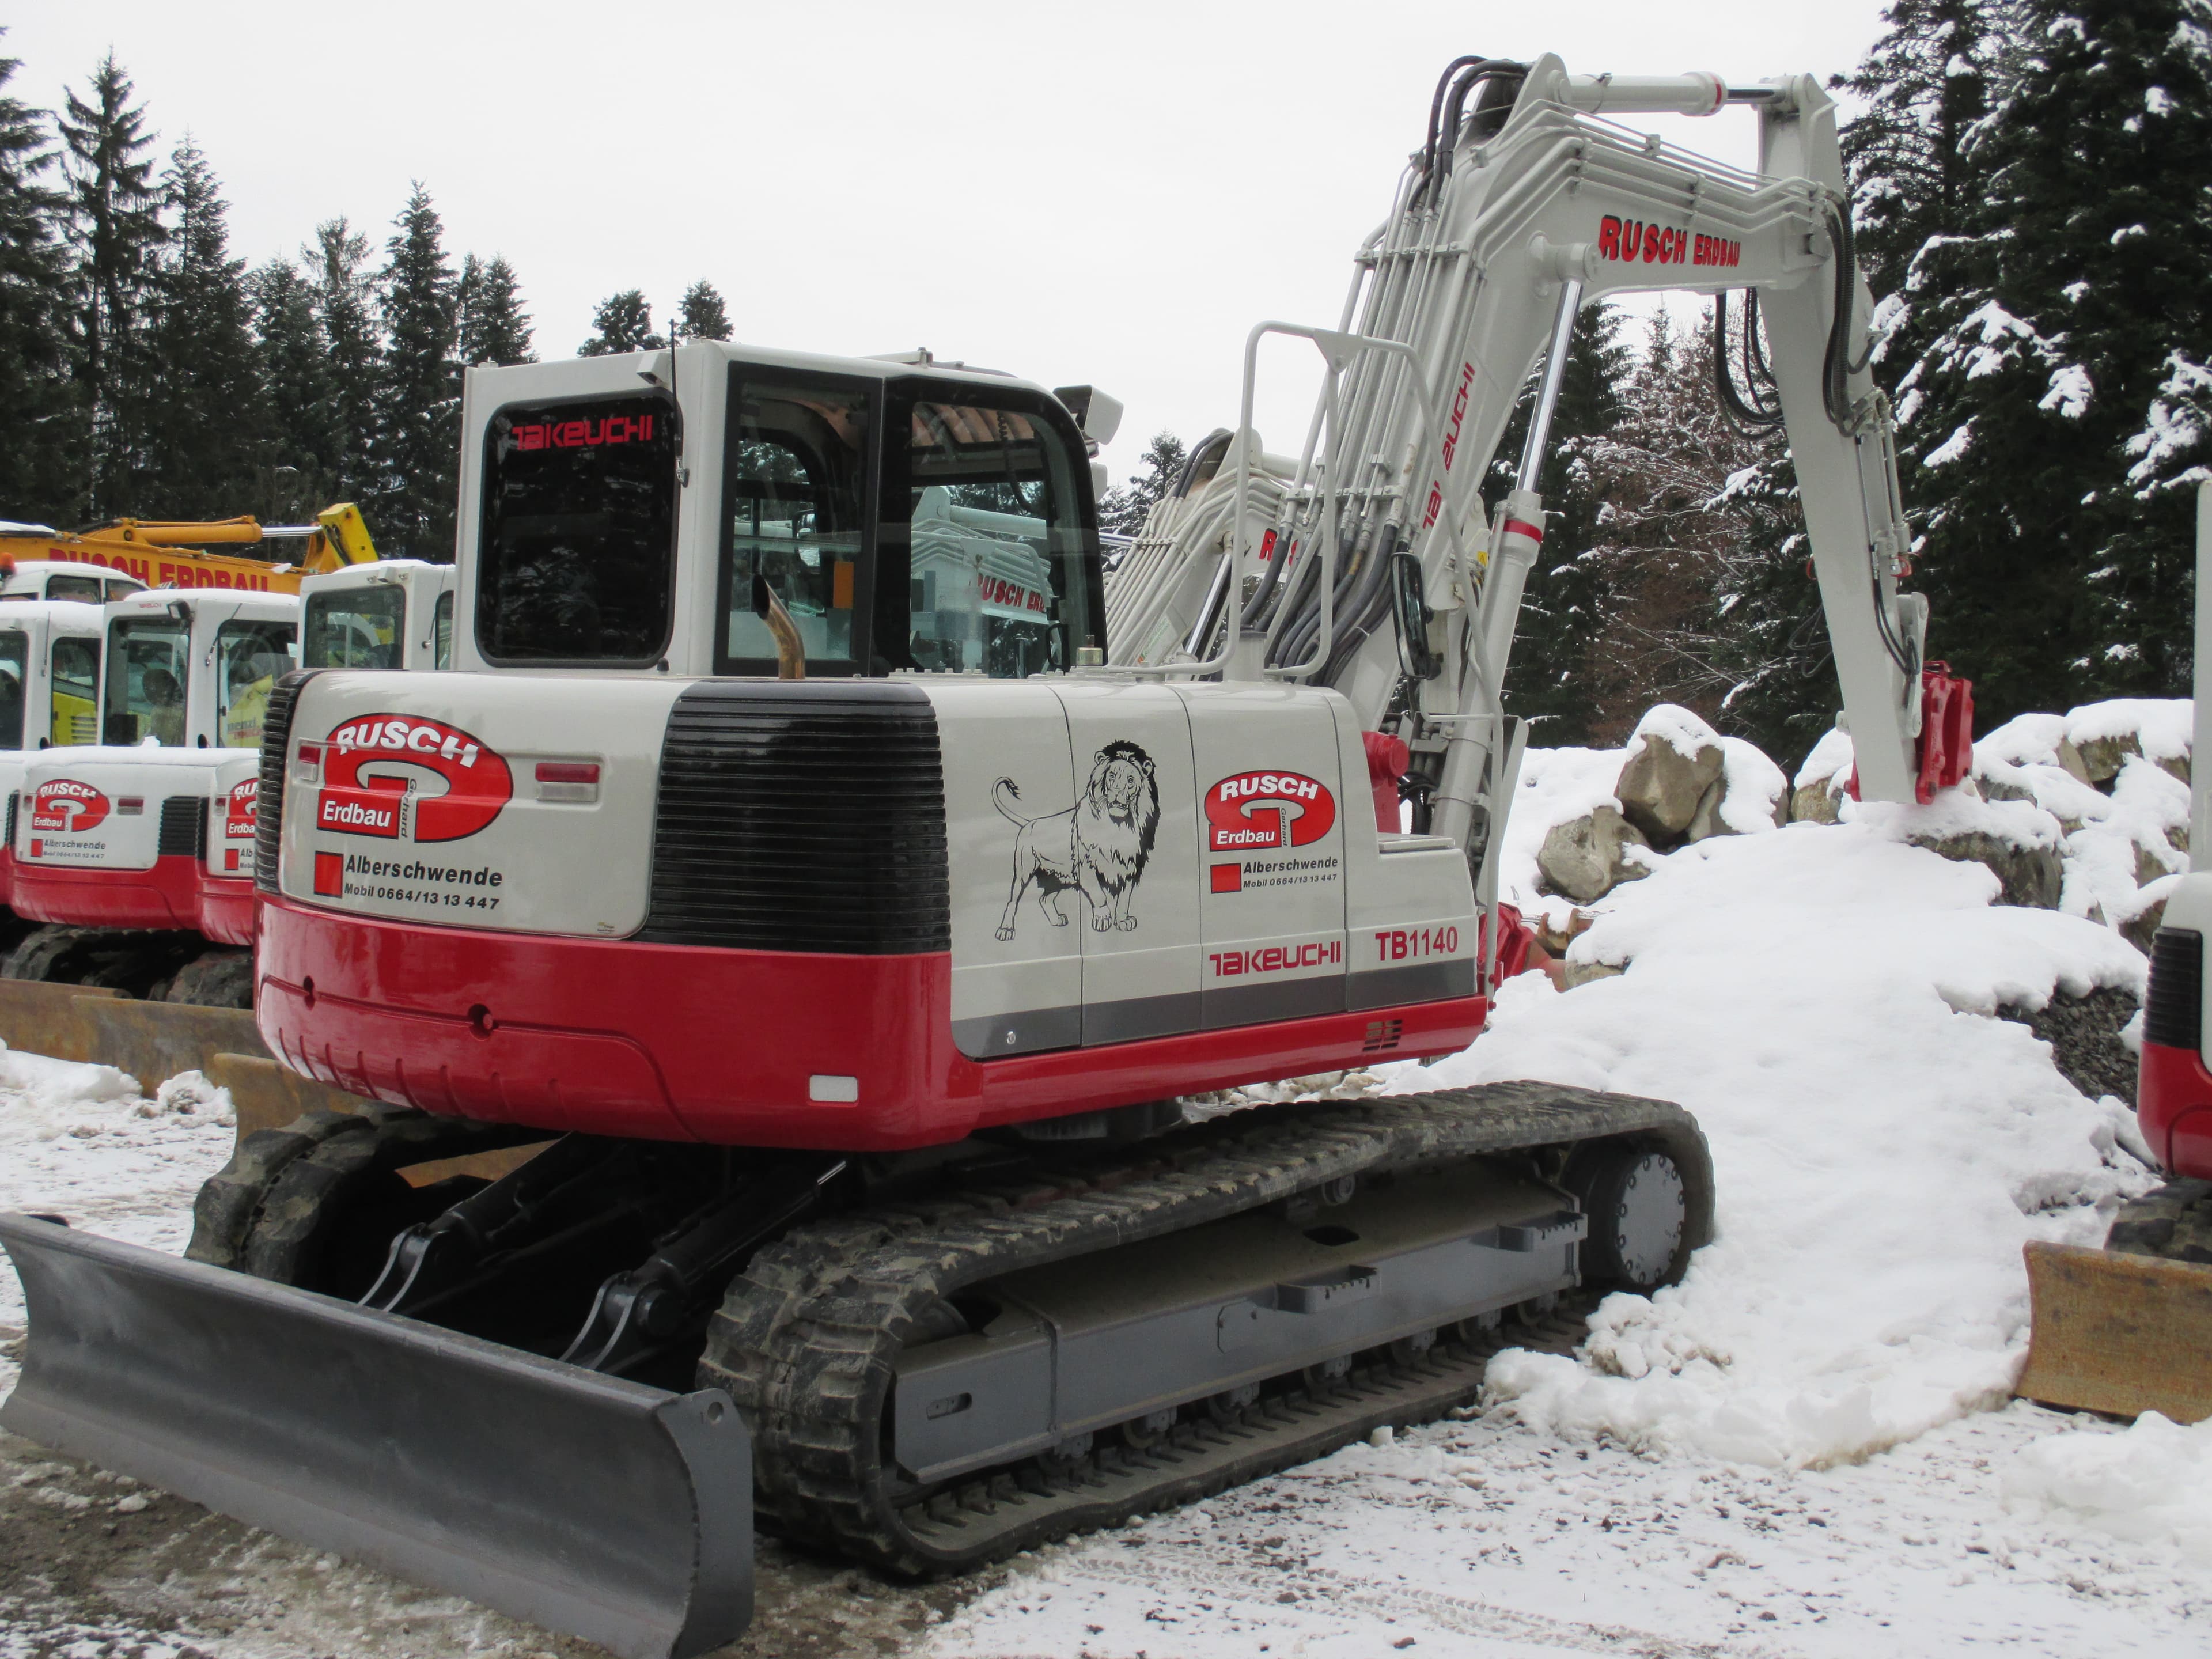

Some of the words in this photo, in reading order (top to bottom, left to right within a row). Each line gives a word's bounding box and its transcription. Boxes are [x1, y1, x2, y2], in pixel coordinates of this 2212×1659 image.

[1598, 214, 1687, 264] RUSCH
[1693, 233, 1741, 267] ERDBAU
[336, 721, 479, 768] RUSCH
[40, 783, 97, 798] RUSCH
[1220, 775, 1319, 802] RUSCH
[323, 800, 392, 827] Erdbau
[401, 778, 417, 838] Gerhard
[34, 817, 63, 827] Erdbau
[229, 823, 255, 834] Erdba
[1217, 830, 1275, 844] Erdbau
[346, 854, 503, 887] Alberschwende
[1243, 856, 1338, 874] Alberschwende
[1243, 878, 1267, 888] Mobil
[1270, 876, 1308, 885] 0664/13
[1321, 873, 1338, 881] 447
[344, 882, 375, 897] Mobil
[377, 887, 439, 904] 0664/13
[444, 893, 461, 906] 13
[1375, 926, 1458, 961] TB1140
